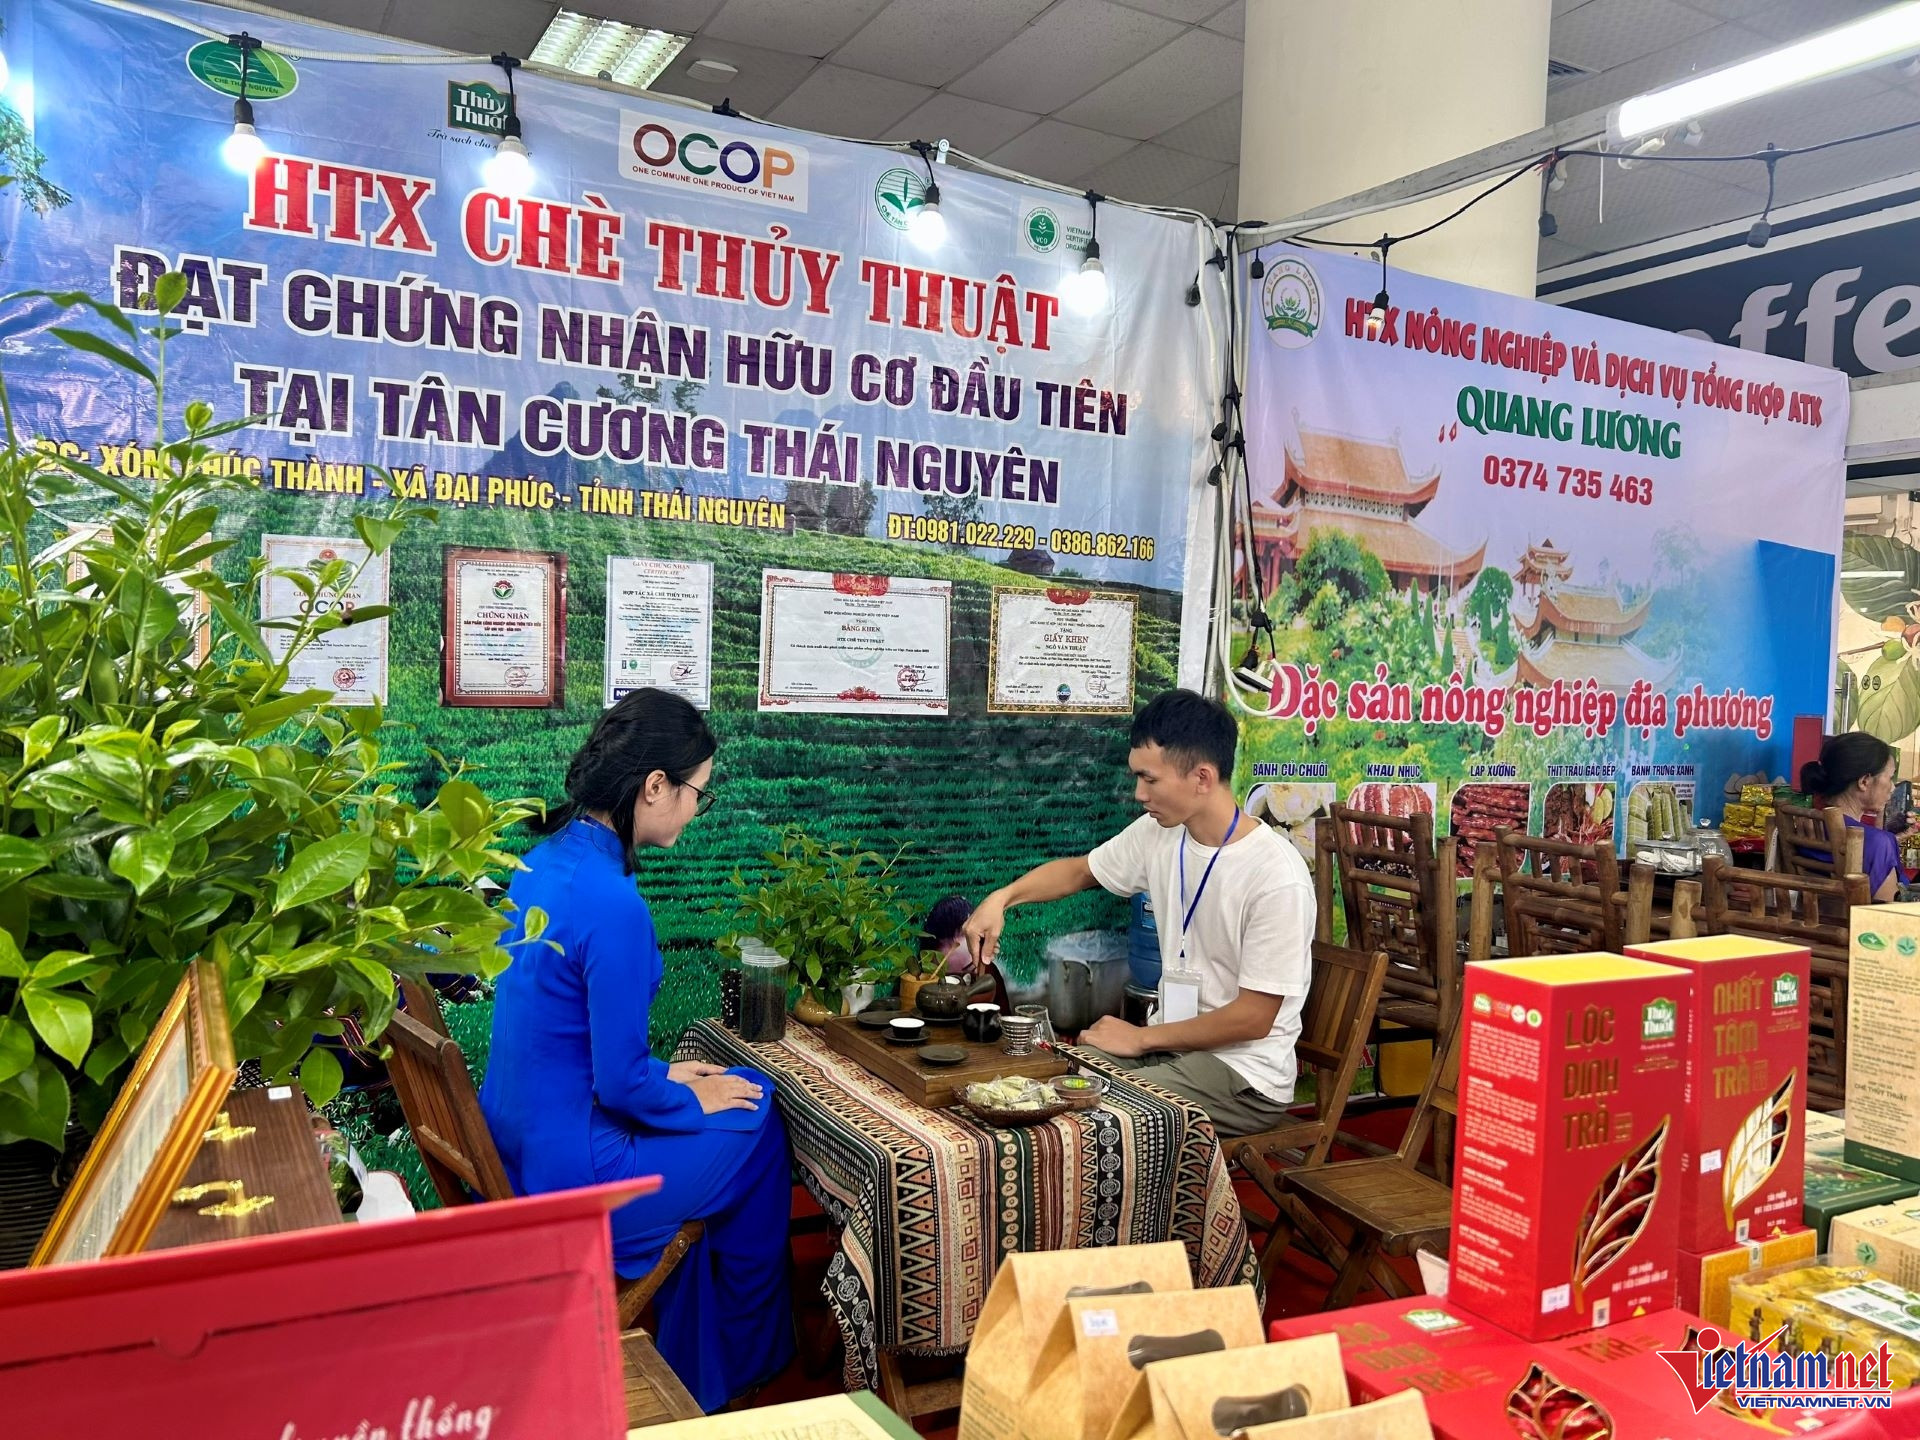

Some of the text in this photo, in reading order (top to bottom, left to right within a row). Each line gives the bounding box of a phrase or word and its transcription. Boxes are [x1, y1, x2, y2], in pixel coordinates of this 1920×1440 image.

[458, 88, 506, 115] Thủy
[474, 139, 491, 148] cho
[633, 123, 795, 189] OCOP
[632, 165, 795, 202] ONE COMMUNE ONE PRODUCT OF VIET NAM
[248, 156, 1059, 354] HTX CHÈ THỦY THUẬT
[1066, 226, 1092, 237] VIETNAM
[115, 249, 1129, 437] ĐẠT CHỨNG NHẬN HỮU CƠ ĐẦU TIÊN
[1676, 266, 1920, 372] ffe
[1405, 306, 1476, 362] NÔNG
[1481, 322, 1567, 385] NGHIỆP
[1571, 340, 1600, 386] VÀ
[1605, 352, 1655, 400] DỊCH
[1659, 363, 1688, 409] VỤ
[1692, 360, 1743, 414] TỔNG
[1747, 380, 1785, 425] HỢP
[1788, 390, 1823, 429] ATK
[239, 368, 1060, 504] TẠI TÂN CƯƠNG THÁI NGUYÊN
[1457, 386, 1683, 460] QUANG LƯƠNG
[100, 440, 171, 480] XÓM
[270, 454, 365, 495] THÀNH
[391, 464, 428, 500] XÃ
[435, 474, 479, 508] ĐẠI
[488, 475, 555, 508] PHÚC
[579, 478, 633, 516] TỈNH
[642, 488, 691, 521] THÁI
[698, 498, 786, 530] NGUYÊN
[1483, 455, 1653, 506] 0374 735 463
[887, 514, 1035, 550] ĐT:0981.022.229
[1050, 528, 1155, 561] 0386.862.166
[477, 610, 530, 620] CHỨNG NHẬN
[841, 624, 881, 633] BẰNG KHEN
[1043, 632, 1089, 644] GIẤY KHEN
[1045, 643, 1057, 651] NGÔ
[1267, 662, 1774, 739] Đặc sản nông nghiệp địa phương
[1676, 765, 1695, 777] XANH
[1564, 1003, 1616, 1053] LỘC
